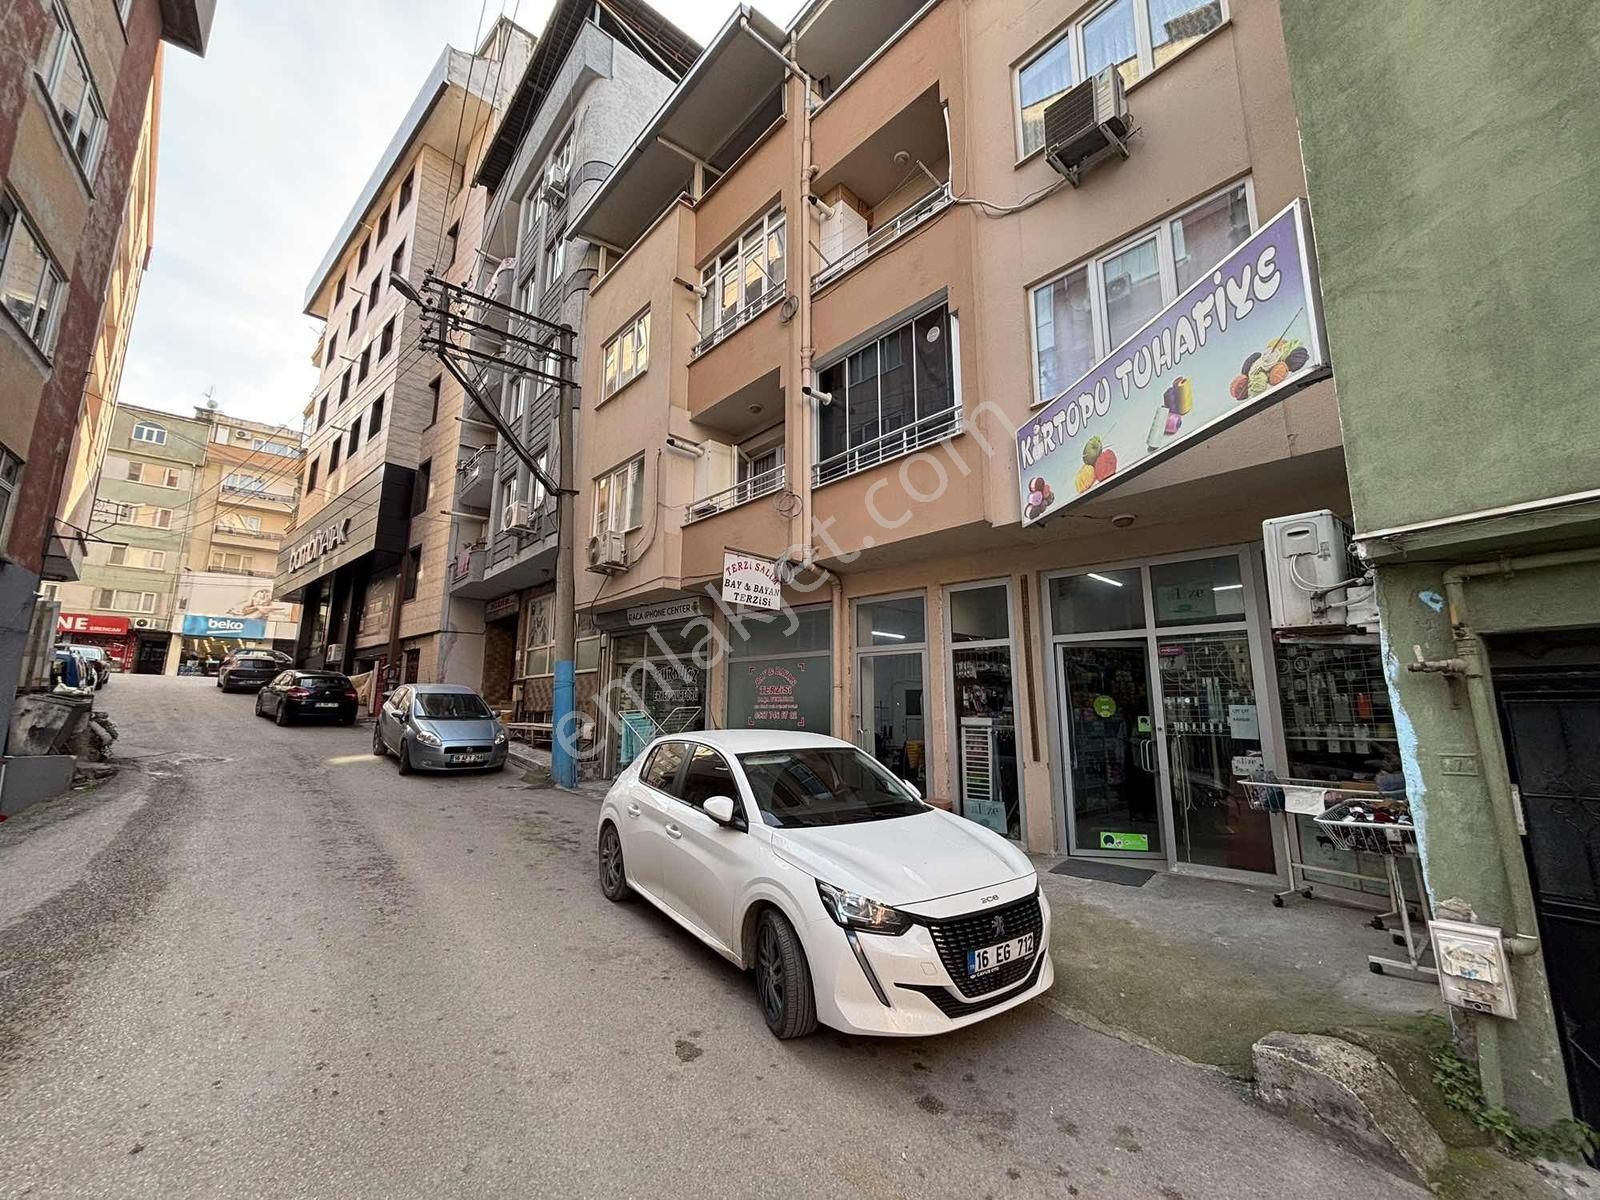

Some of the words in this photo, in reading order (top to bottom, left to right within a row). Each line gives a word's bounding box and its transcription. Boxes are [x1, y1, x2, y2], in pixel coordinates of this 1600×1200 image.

[724, 578, 742, 589] BAY
[744, 582, 752, 591] &
[753, 584, 780, 597] BAYAN
[666, 604, 691, 616] CENTER
[208, 618, 244, 630] beko
[976, 950, 989, 970] 16
[996, 943, 1011, 963] EG
[1017, 934, 1033, 956] 712
